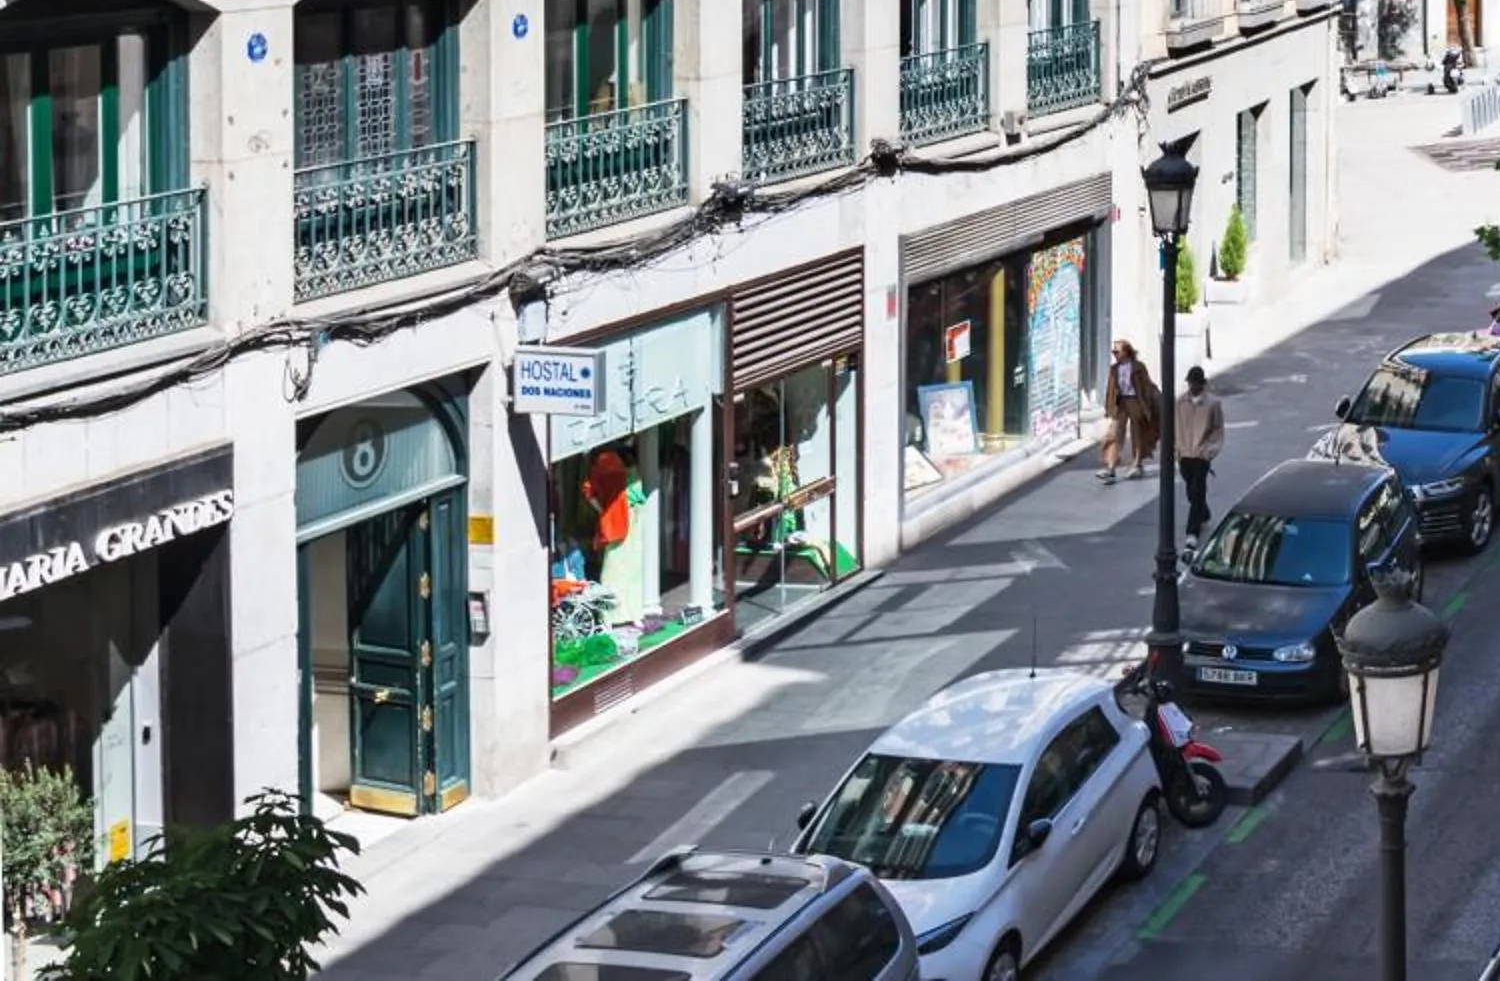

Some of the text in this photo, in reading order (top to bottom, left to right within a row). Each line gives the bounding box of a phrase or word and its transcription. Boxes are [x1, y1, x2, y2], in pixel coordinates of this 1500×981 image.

[521, 359, 578, 382] HOSTAL
[521, 384, 592, 399] DOS NACIONES
[0, 488, 235, 601] ARIA GRANDES
